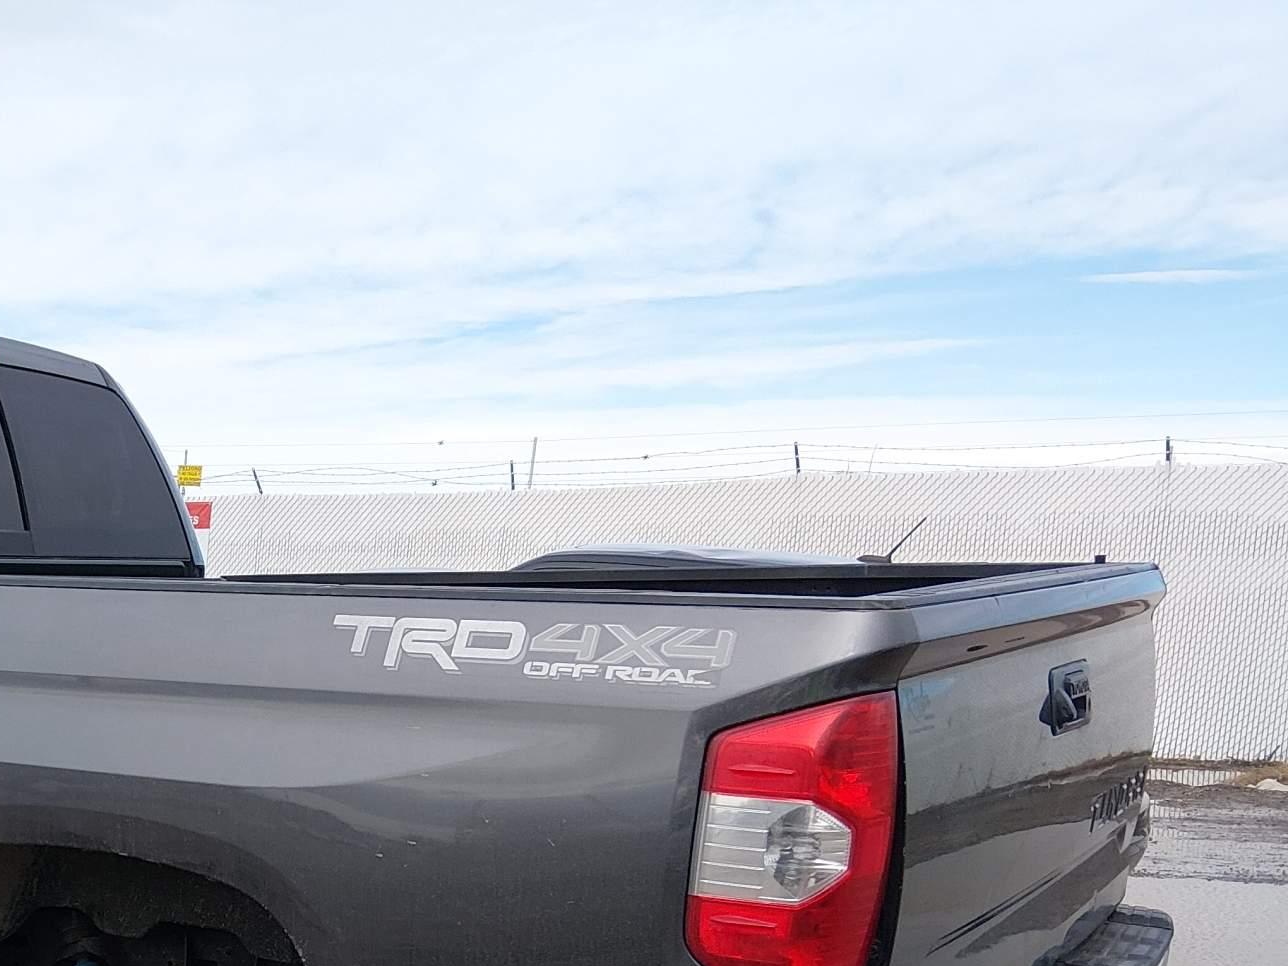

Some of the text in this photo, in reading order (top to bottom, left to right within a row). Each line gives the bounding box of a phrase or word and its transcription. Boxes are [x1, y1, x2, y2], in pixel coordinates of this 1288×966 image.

[333, 615, 737, 674] TRD 4X4
[523, 661, 600, 681] OFF
